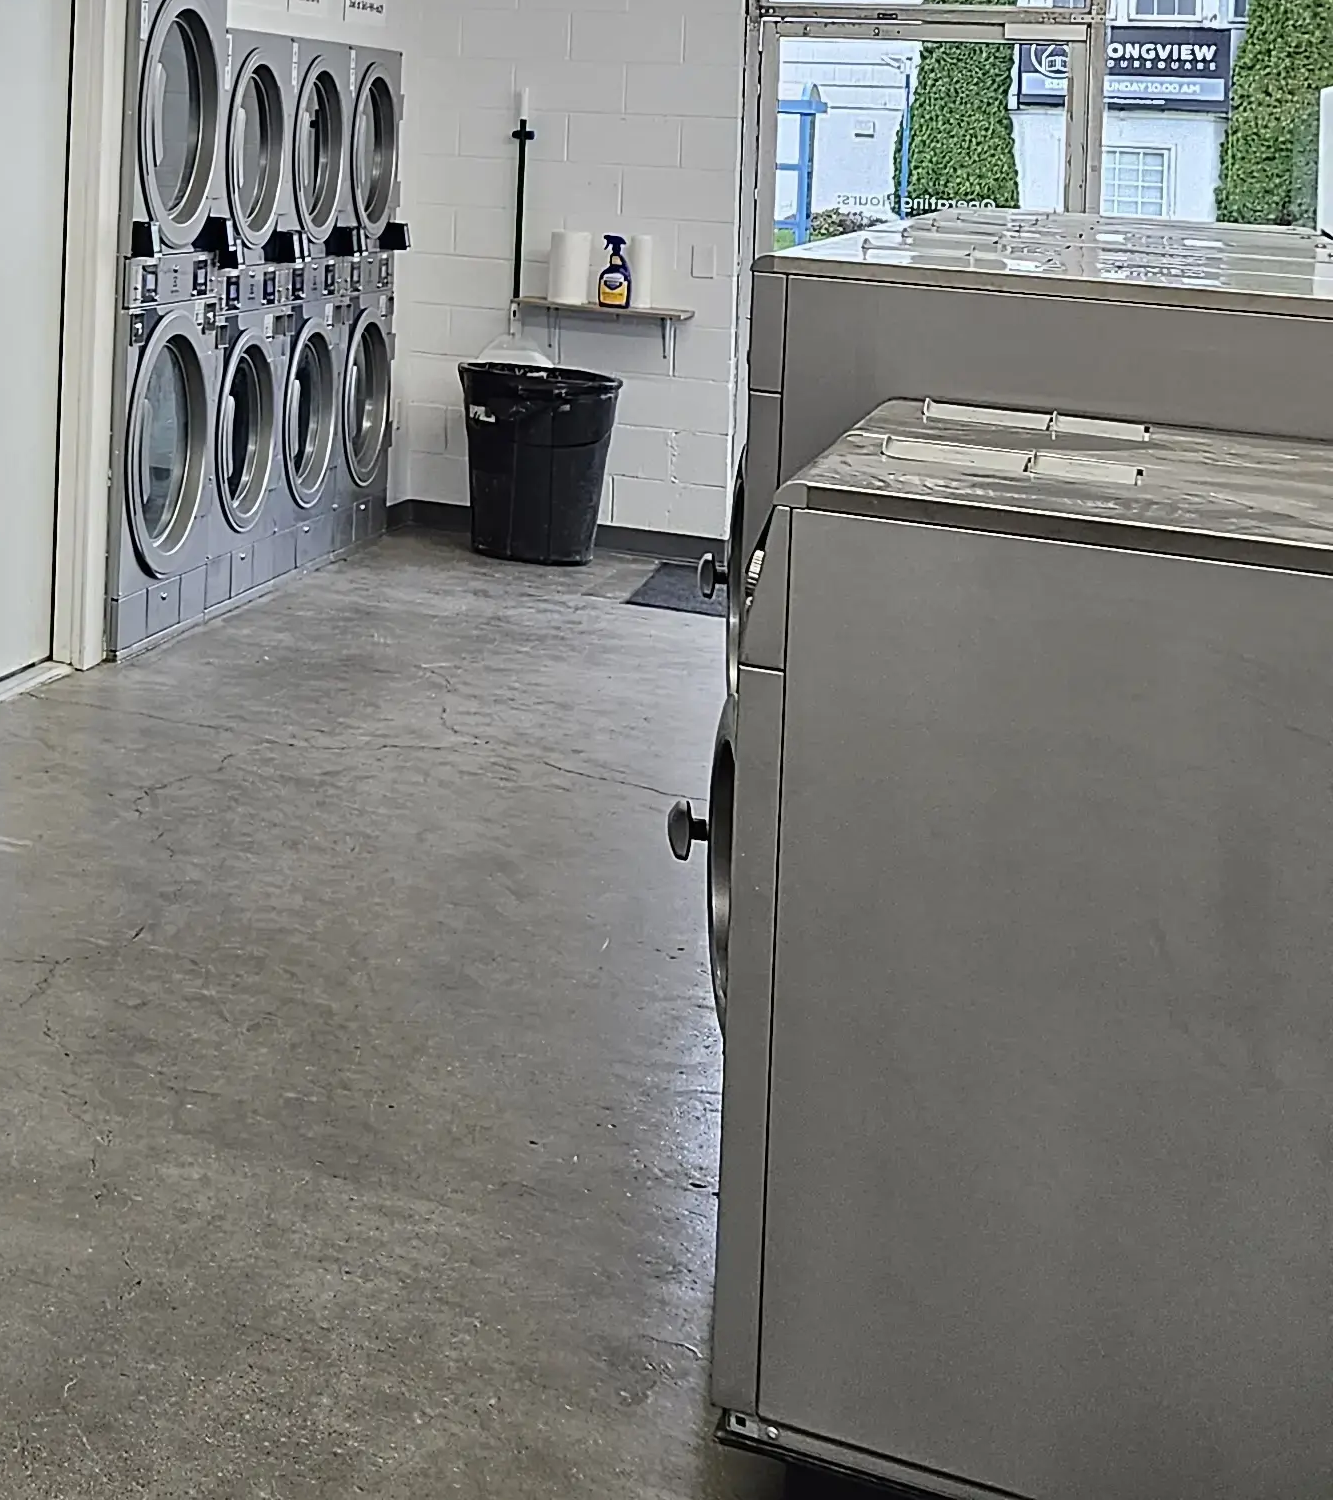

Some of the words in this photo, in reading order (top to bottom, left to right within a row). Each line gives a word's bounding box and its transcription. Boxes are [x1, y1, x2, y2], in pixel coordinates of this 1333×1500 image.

[1106, 42, 1217, 61] ONGVIEW
[1106, 60, 1217, 71] OURSQUARE
[1106, 81, 1146, 92] UNDAY
[1180, 83, 1201, 94] AM
